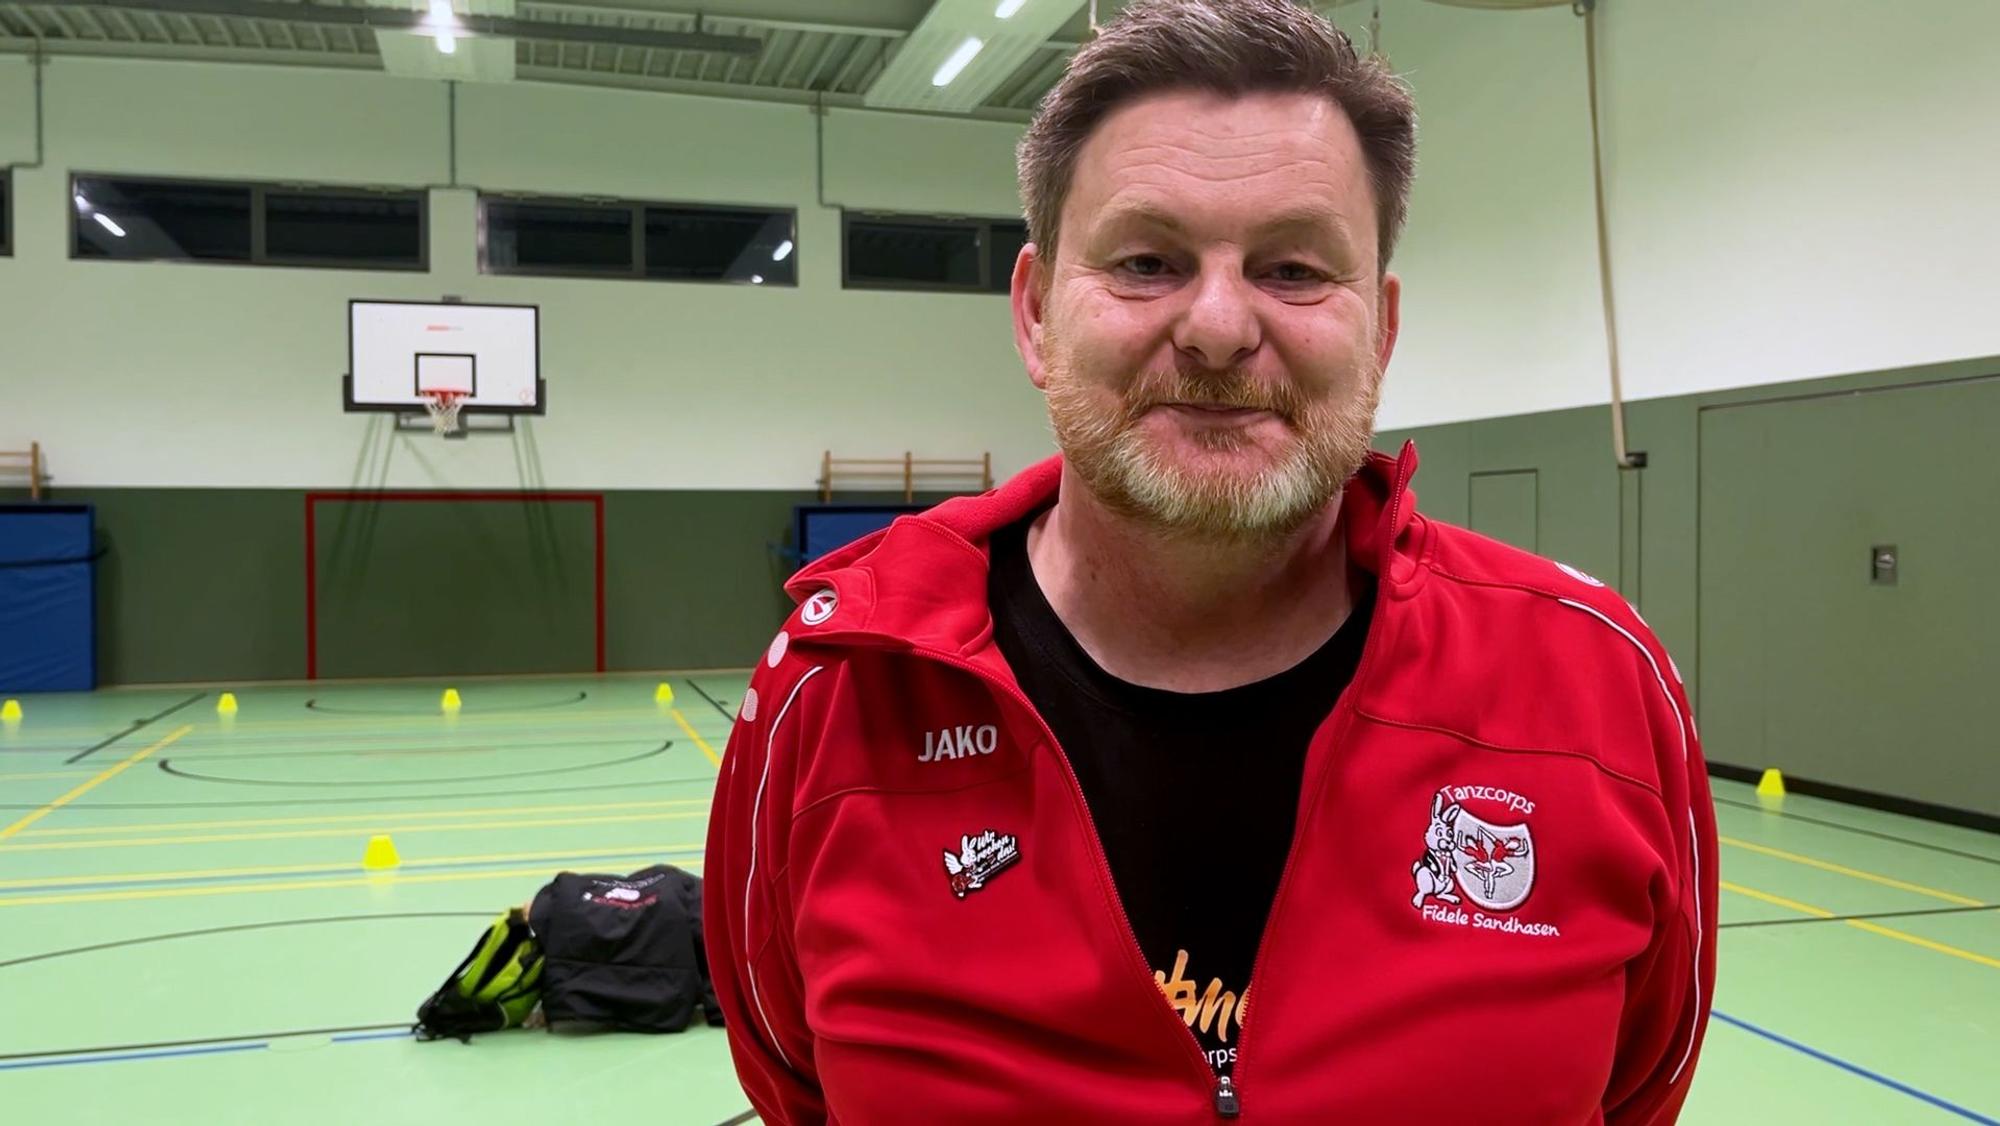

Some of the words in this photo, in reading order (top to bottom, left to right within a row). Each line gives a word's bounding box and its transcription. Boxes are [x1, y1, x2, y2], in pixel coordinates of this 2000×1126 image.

[918, 725, 998, 762] JAKO
[1440, 785, 1535, 814] Tanzcorps
[1421, 904, 1469, 926] Fidele
[1472, 913, 1560, 936] Sandhasen
